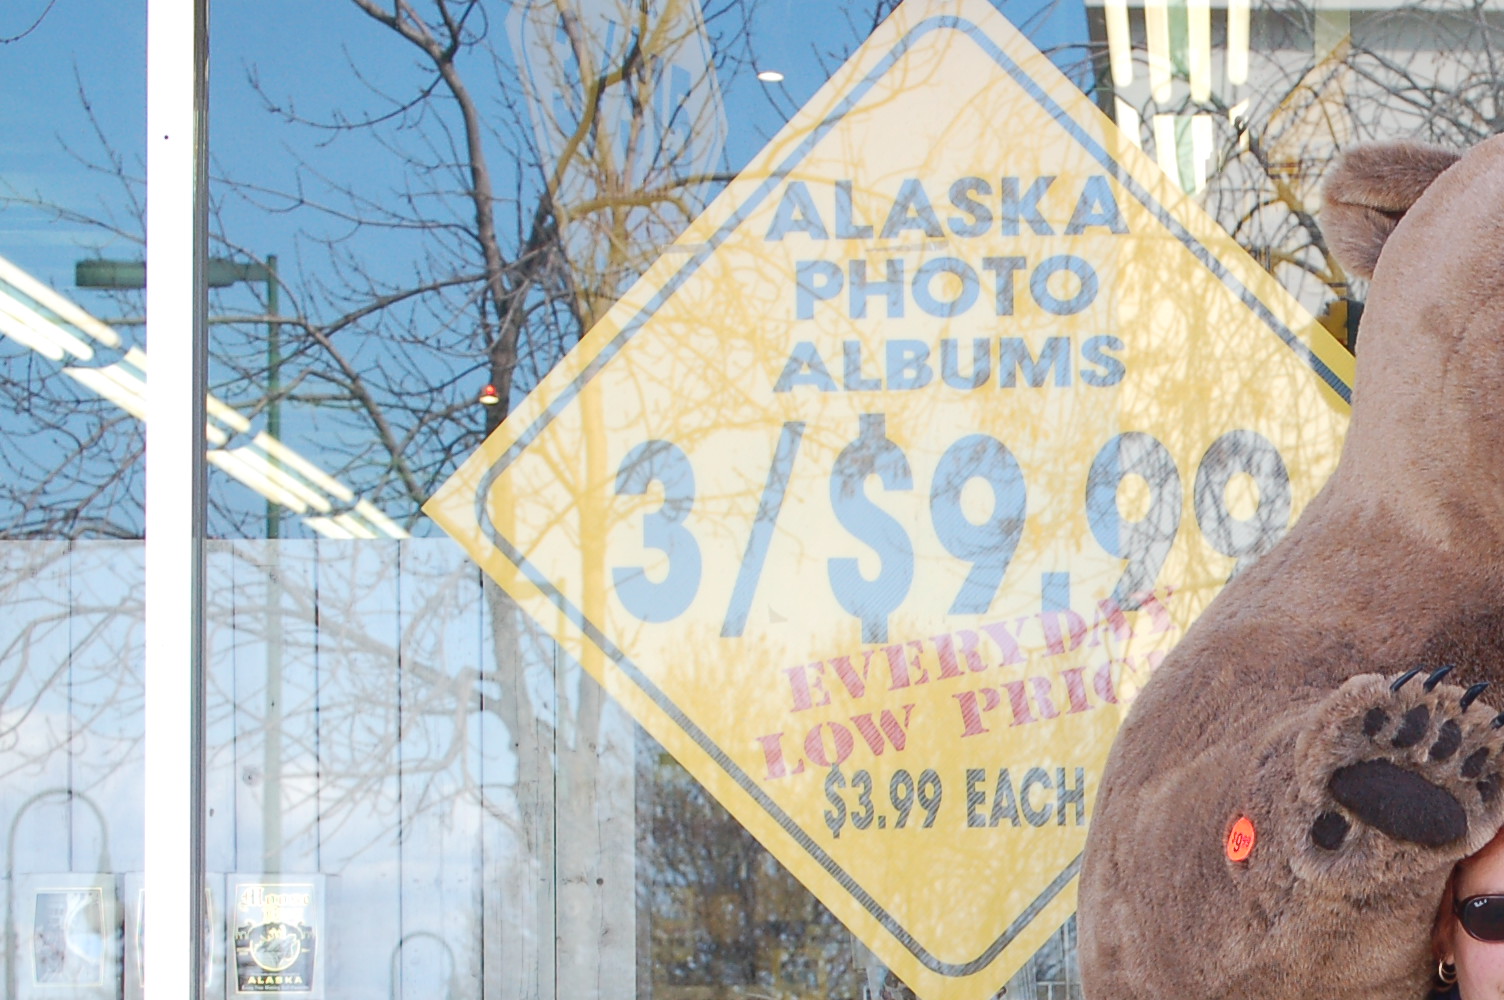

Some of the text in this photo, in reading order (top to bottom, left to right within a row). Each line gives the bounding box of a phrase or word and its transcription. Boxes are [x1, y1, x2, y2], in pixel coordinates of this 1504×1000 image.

[763, 173, 1129, 241] ALASKA
[796, 254, 1098, 320] PHOTO
[773, 334, 1127, 394] ALBUMS
[783, 585, 1180, 713] EVERYDAY
[756, 703, 916, 781] LOW
[823, 763, 1086, 839] $3.99 EACH
[247, 975, 303, 984] ALASKA
